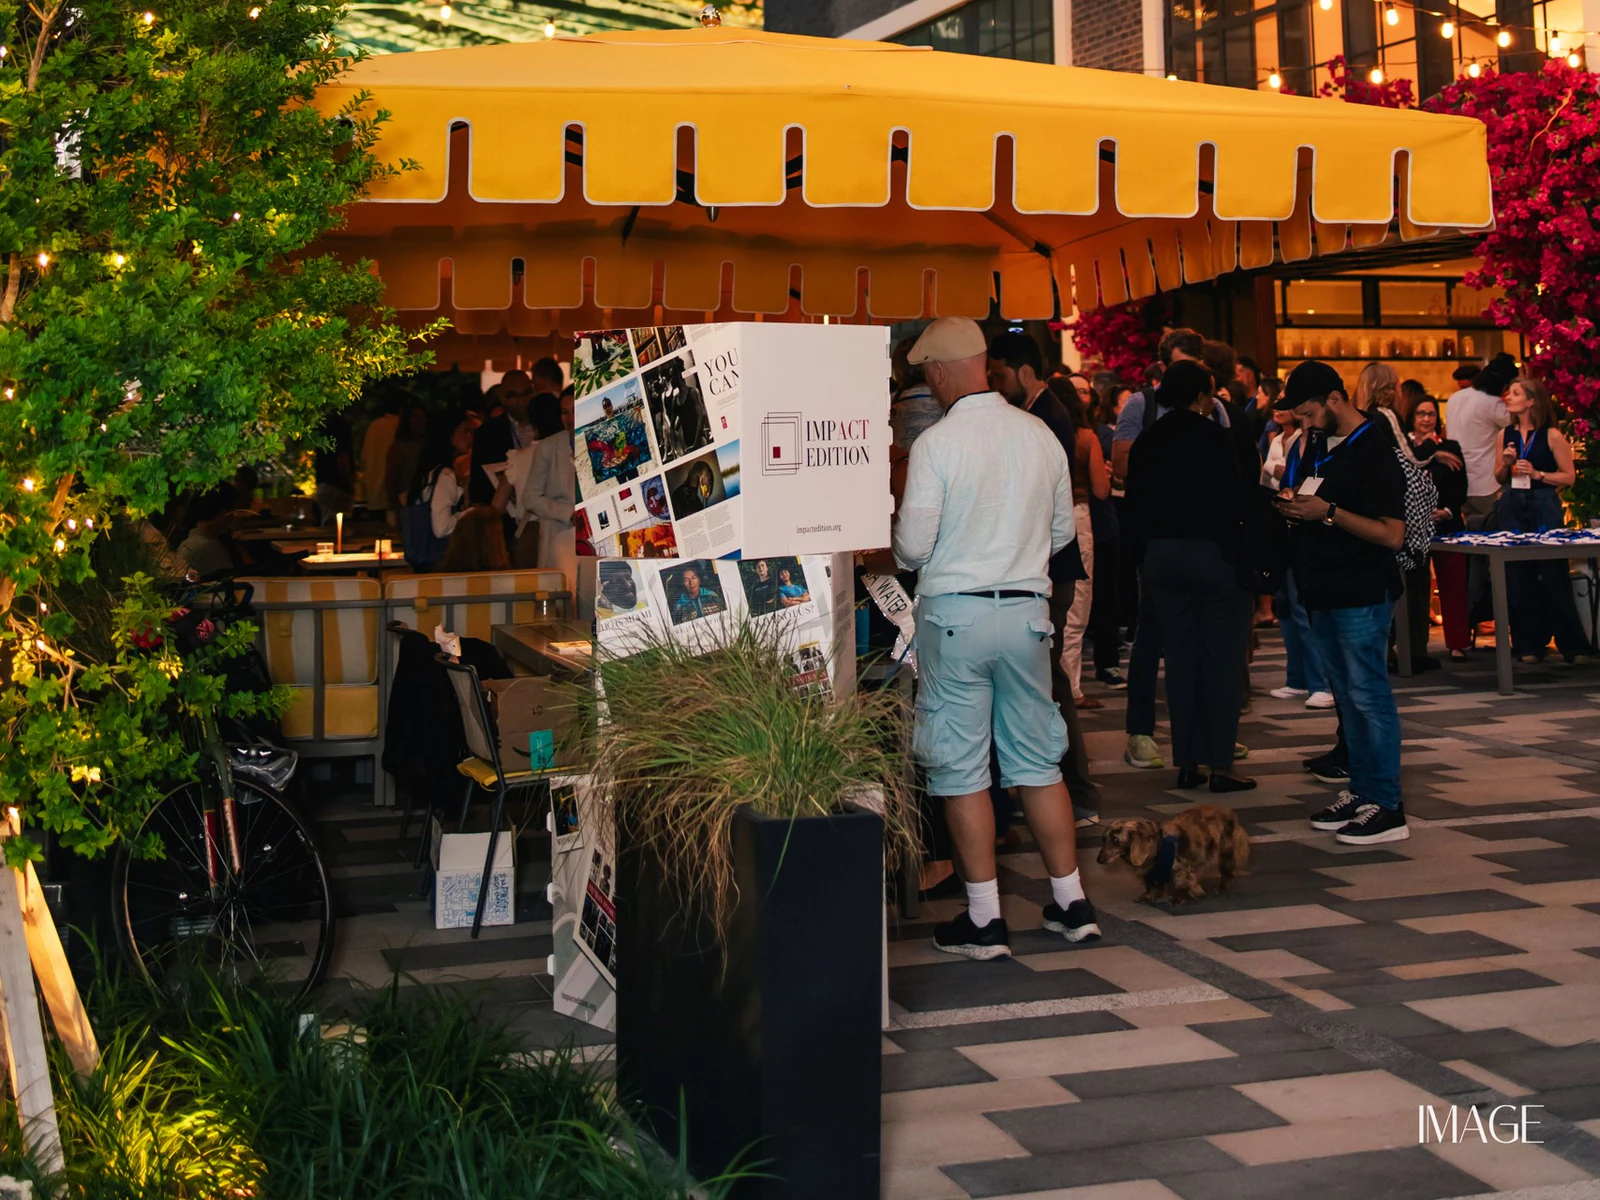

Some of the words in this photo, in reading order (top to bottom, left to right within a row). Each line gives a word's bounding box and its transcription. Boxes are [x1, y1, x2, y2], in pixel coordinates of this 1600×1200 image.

[703, 347, 739, 377] YOU
[806, 419, 870, 441] IMPACT
[806, 445, 870, 467] EDITION
[796, 523, 842, 535] impactedition.org
[875, 577, 908, 617] WATER
